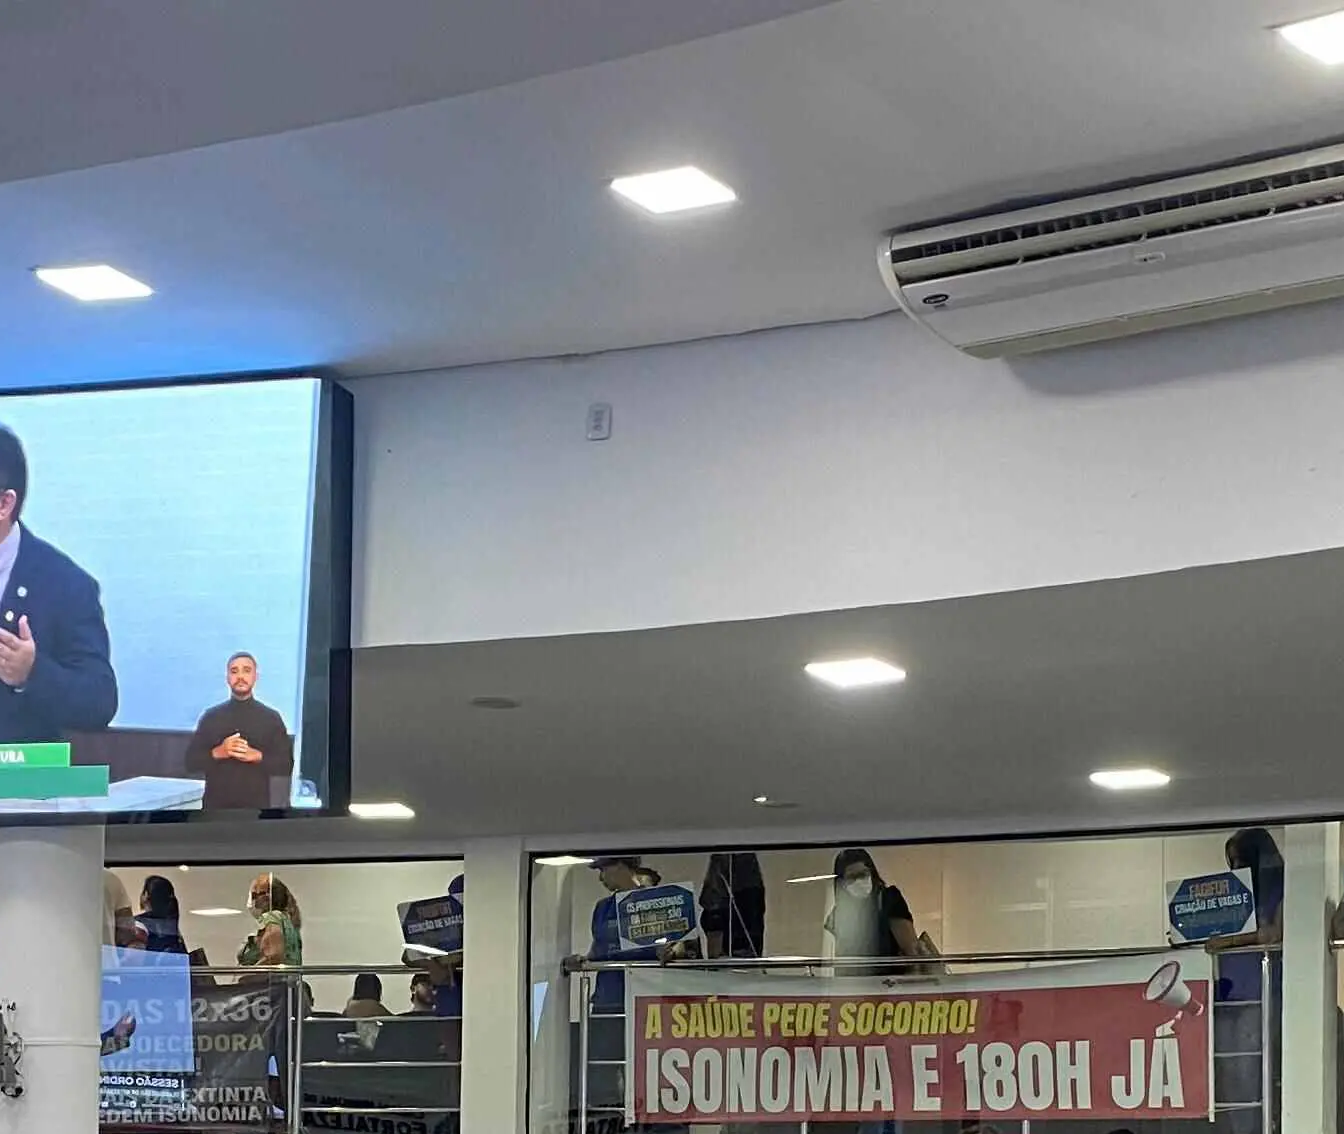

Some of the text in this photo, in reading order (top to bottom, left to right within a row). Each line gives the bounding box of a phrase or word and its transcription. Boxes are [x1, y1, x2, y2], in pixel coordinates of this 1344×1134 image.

[1207, 899, 1217, 909] DE
[1218, 895, 1242, 907] VAGAS
[175, 996, 273, 1023] 12x36
[644, 996, 979, 1039] A SAÚDE PEDE SOCORRO!
[646, 1045, 895, 1114] ISONOMIA
[910, 1044, 942, 1112] E
[1111, 1025, 1185, 1109] JÁ
[159, 1105, 262, 1123] ISONOMIA
